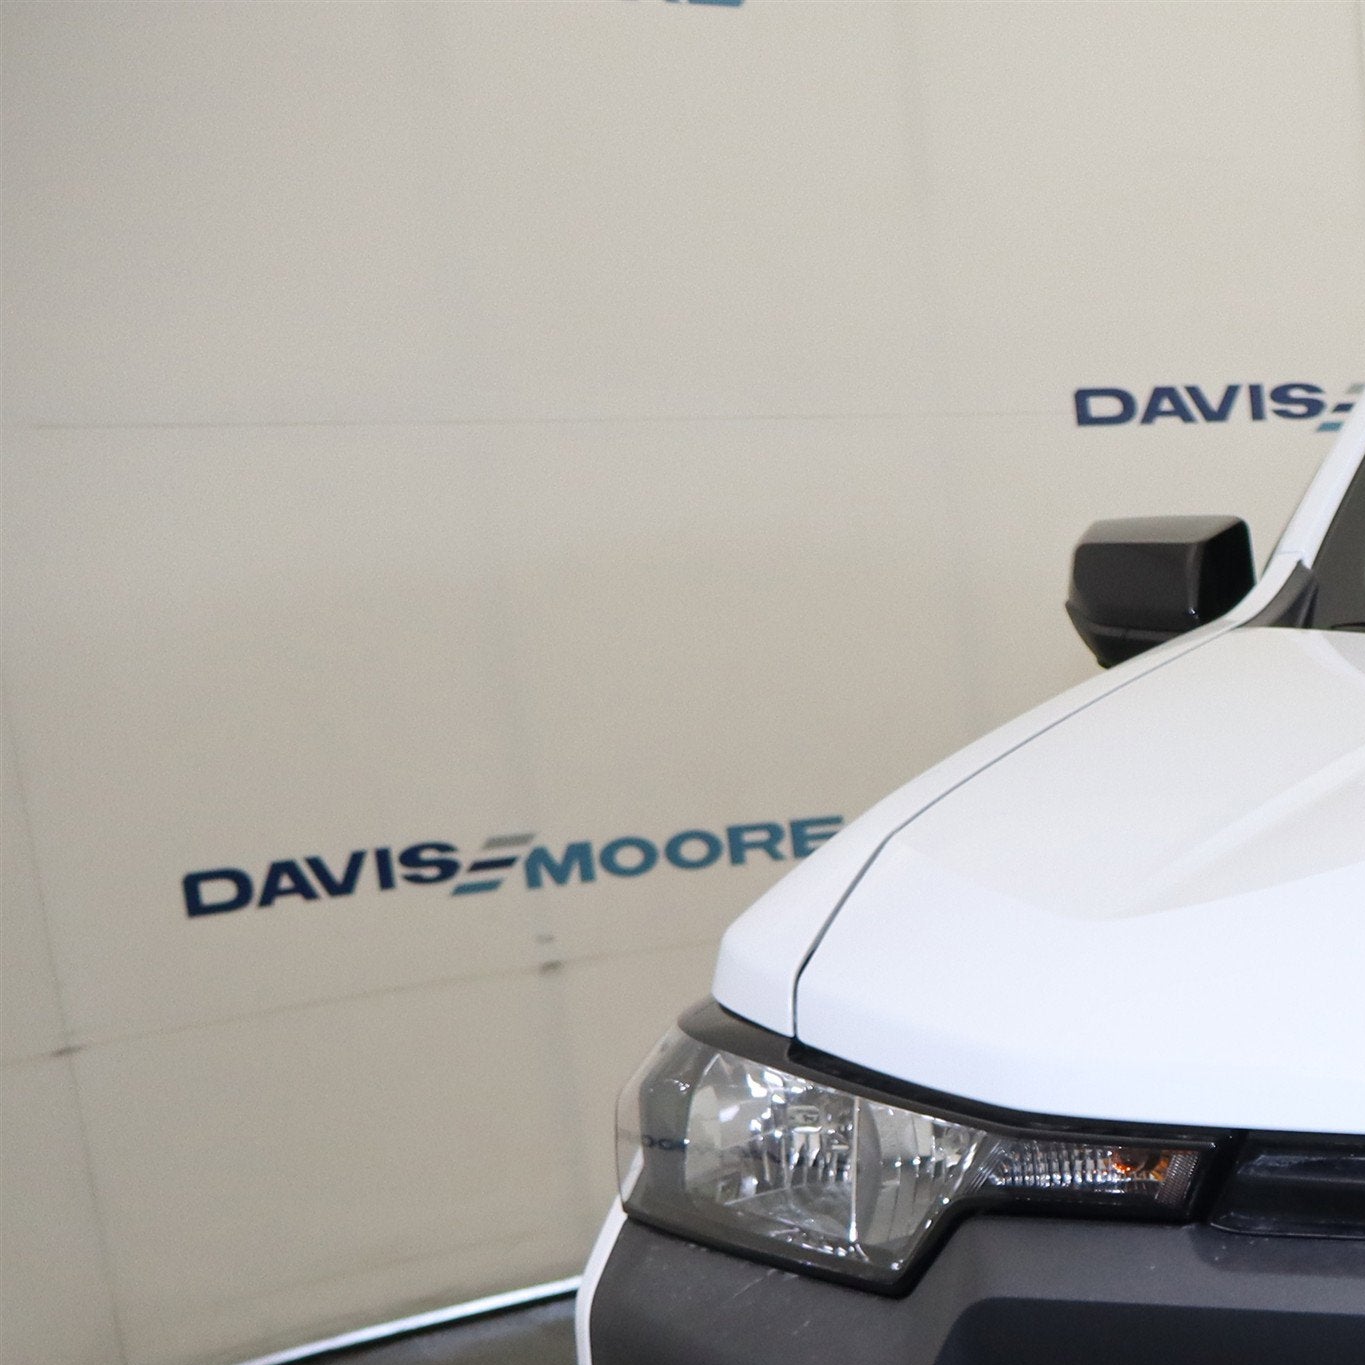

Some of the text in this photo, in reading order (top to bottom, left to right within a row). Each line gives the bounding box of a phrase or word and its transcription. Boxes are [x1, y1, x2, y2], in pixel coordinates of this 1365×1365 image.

[1074, 383, 1326, 426] DAVIS
[182, 815, 843, 918] DAVIS MOORE
